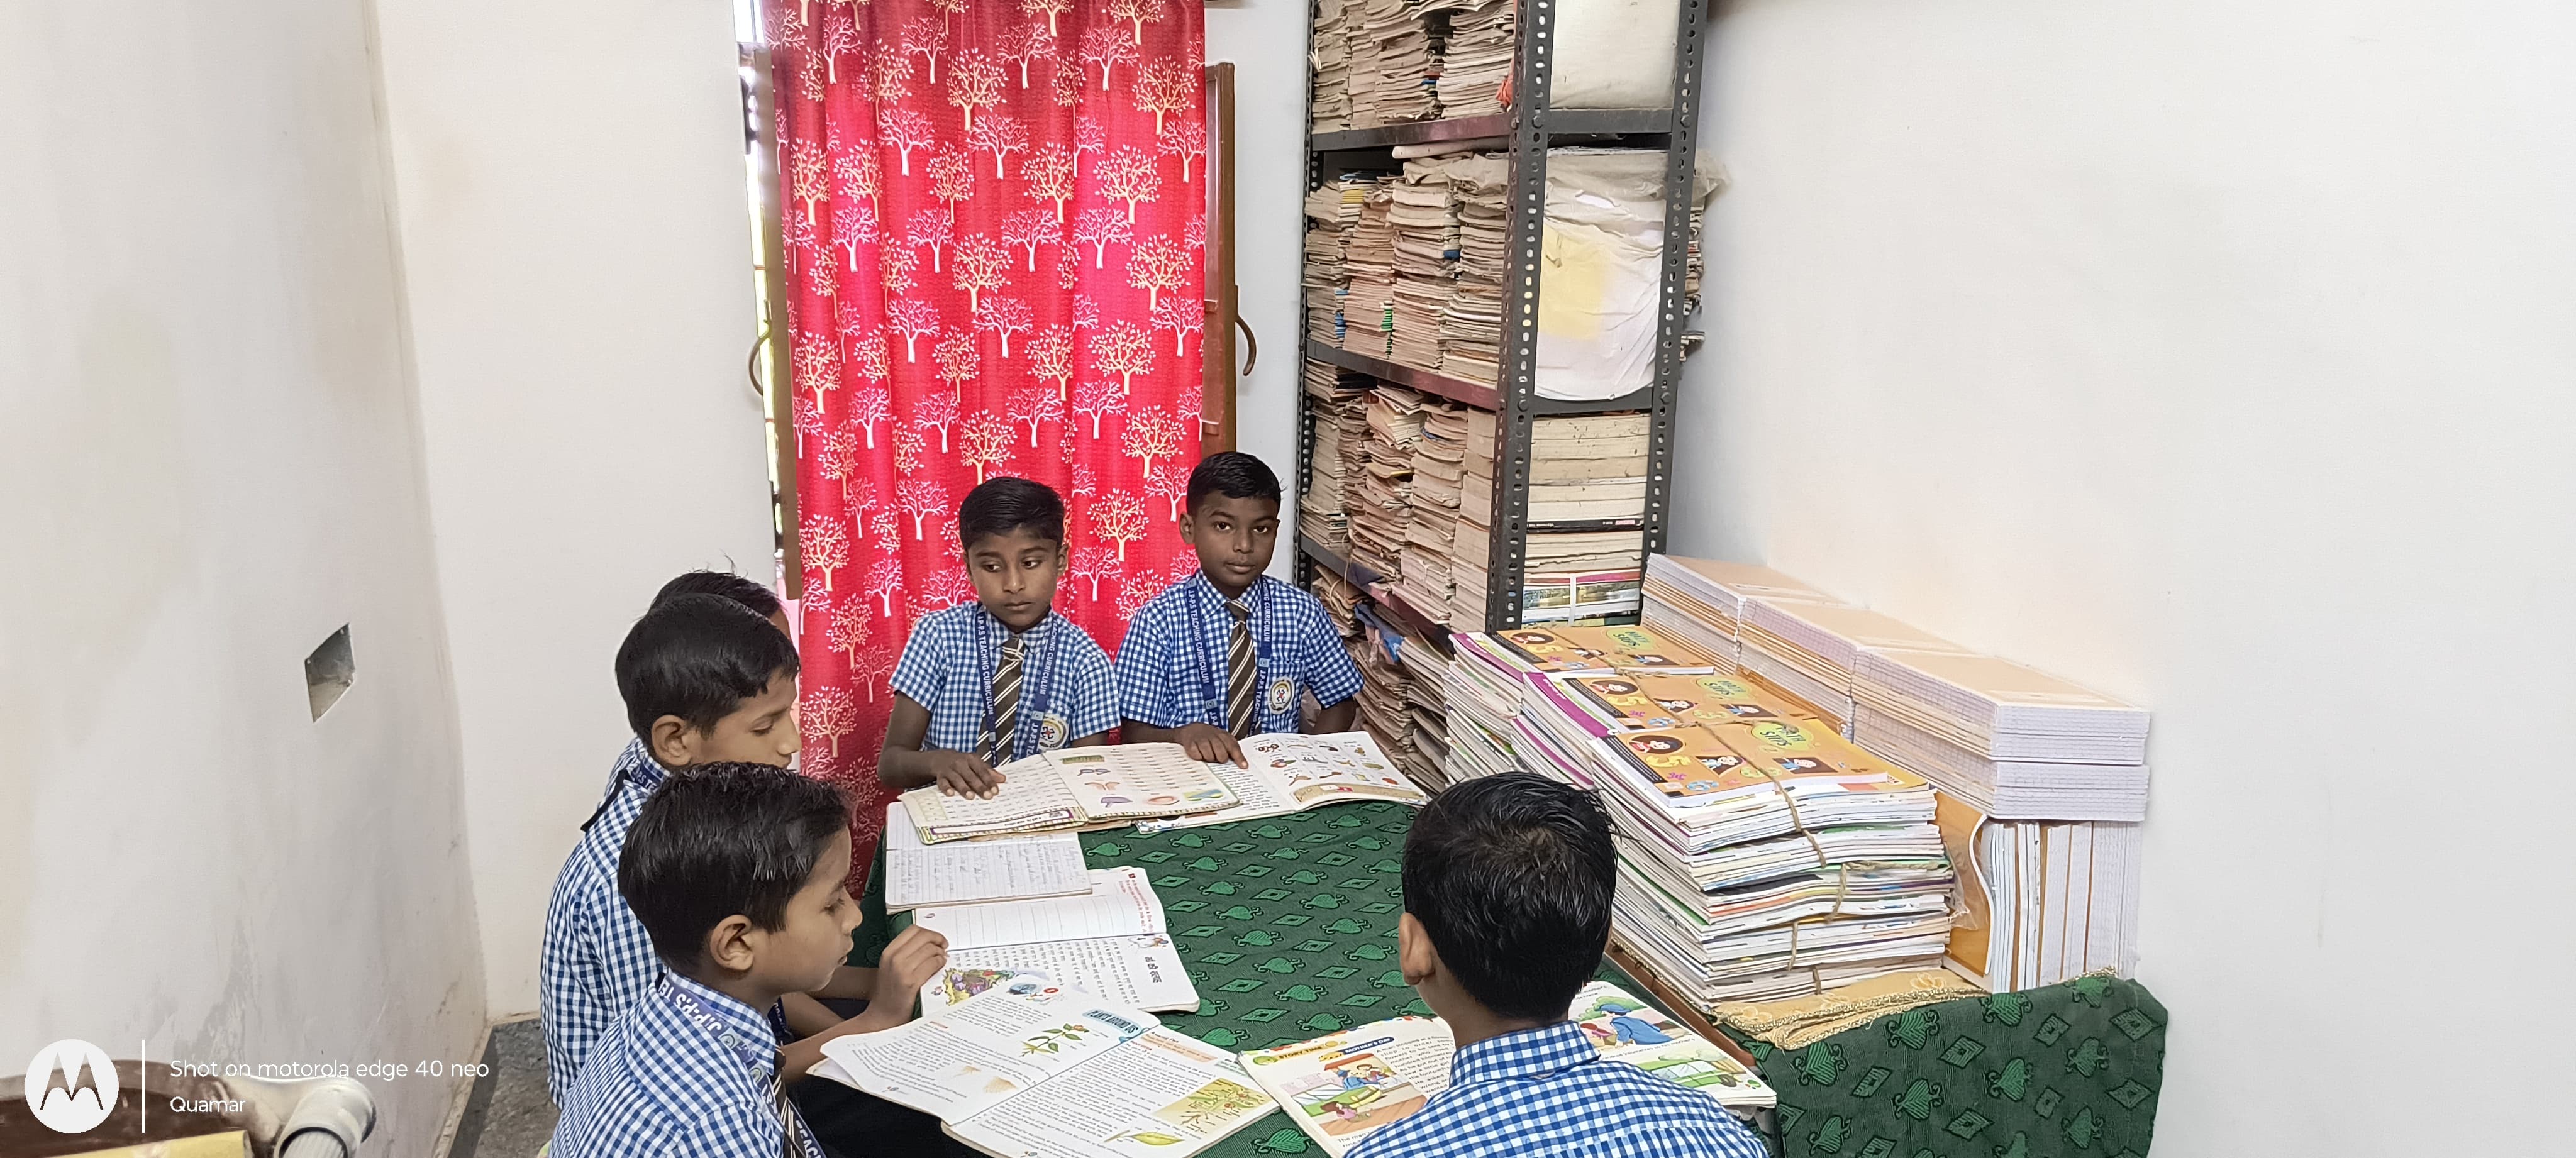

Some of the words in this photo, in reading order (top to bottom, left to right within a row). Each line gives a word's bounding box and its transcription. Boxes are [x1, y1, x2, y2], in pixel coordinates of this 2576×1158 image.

[978, 636, 989, 671] TEACHING
[1190, 610, 1201, 643] TEACHING
[1196, 641, 1210, 684] CURRICULUM
[1040, 652, 1054, 695] CURRICULUM
[982, 671, 994, 715] CURRICULUM
[1087, 1011, 1110, 1020] PLANTS
[1106, 1016, 1130, 1028] AROUND
[1125, 1025, 1138, 1033] US
[1278, 1049, 1304, 1059] STORY
[1345, 1041, 1377, 1054] MOTHER'S
